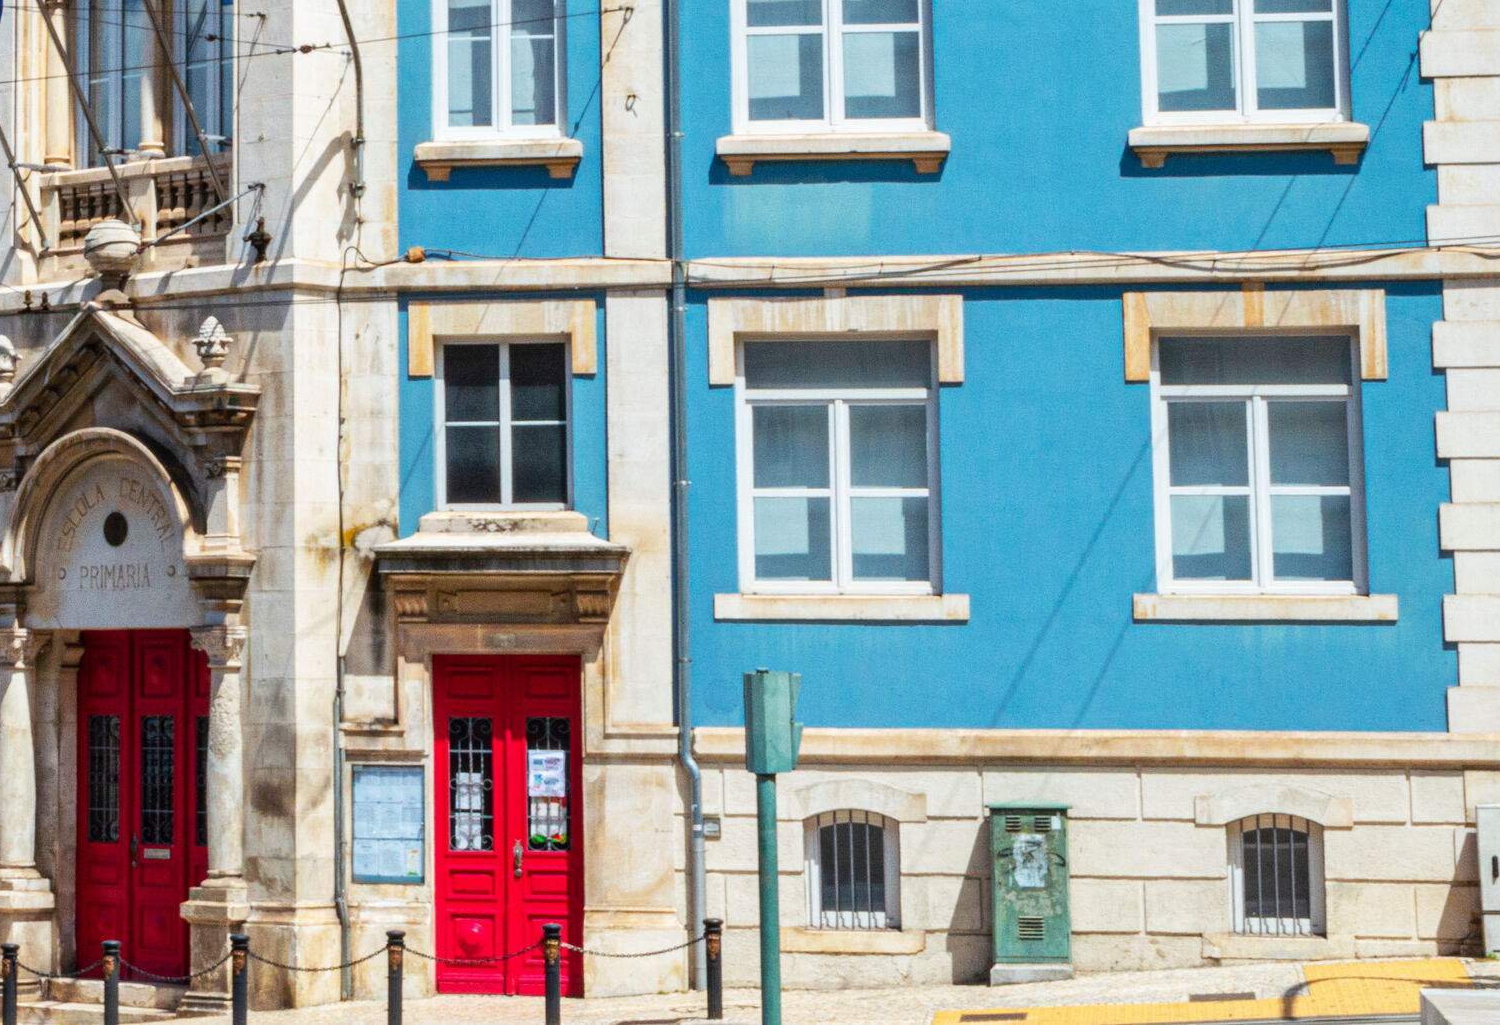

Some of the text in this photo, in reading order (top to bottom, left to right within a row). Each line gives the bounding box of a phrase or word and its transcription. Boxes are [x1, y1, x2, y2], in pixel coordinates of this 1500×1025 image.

[57, 477, 176, 552] ESCOLA CENTRAL
[79, 564, 151, 591] PRIMARIA
